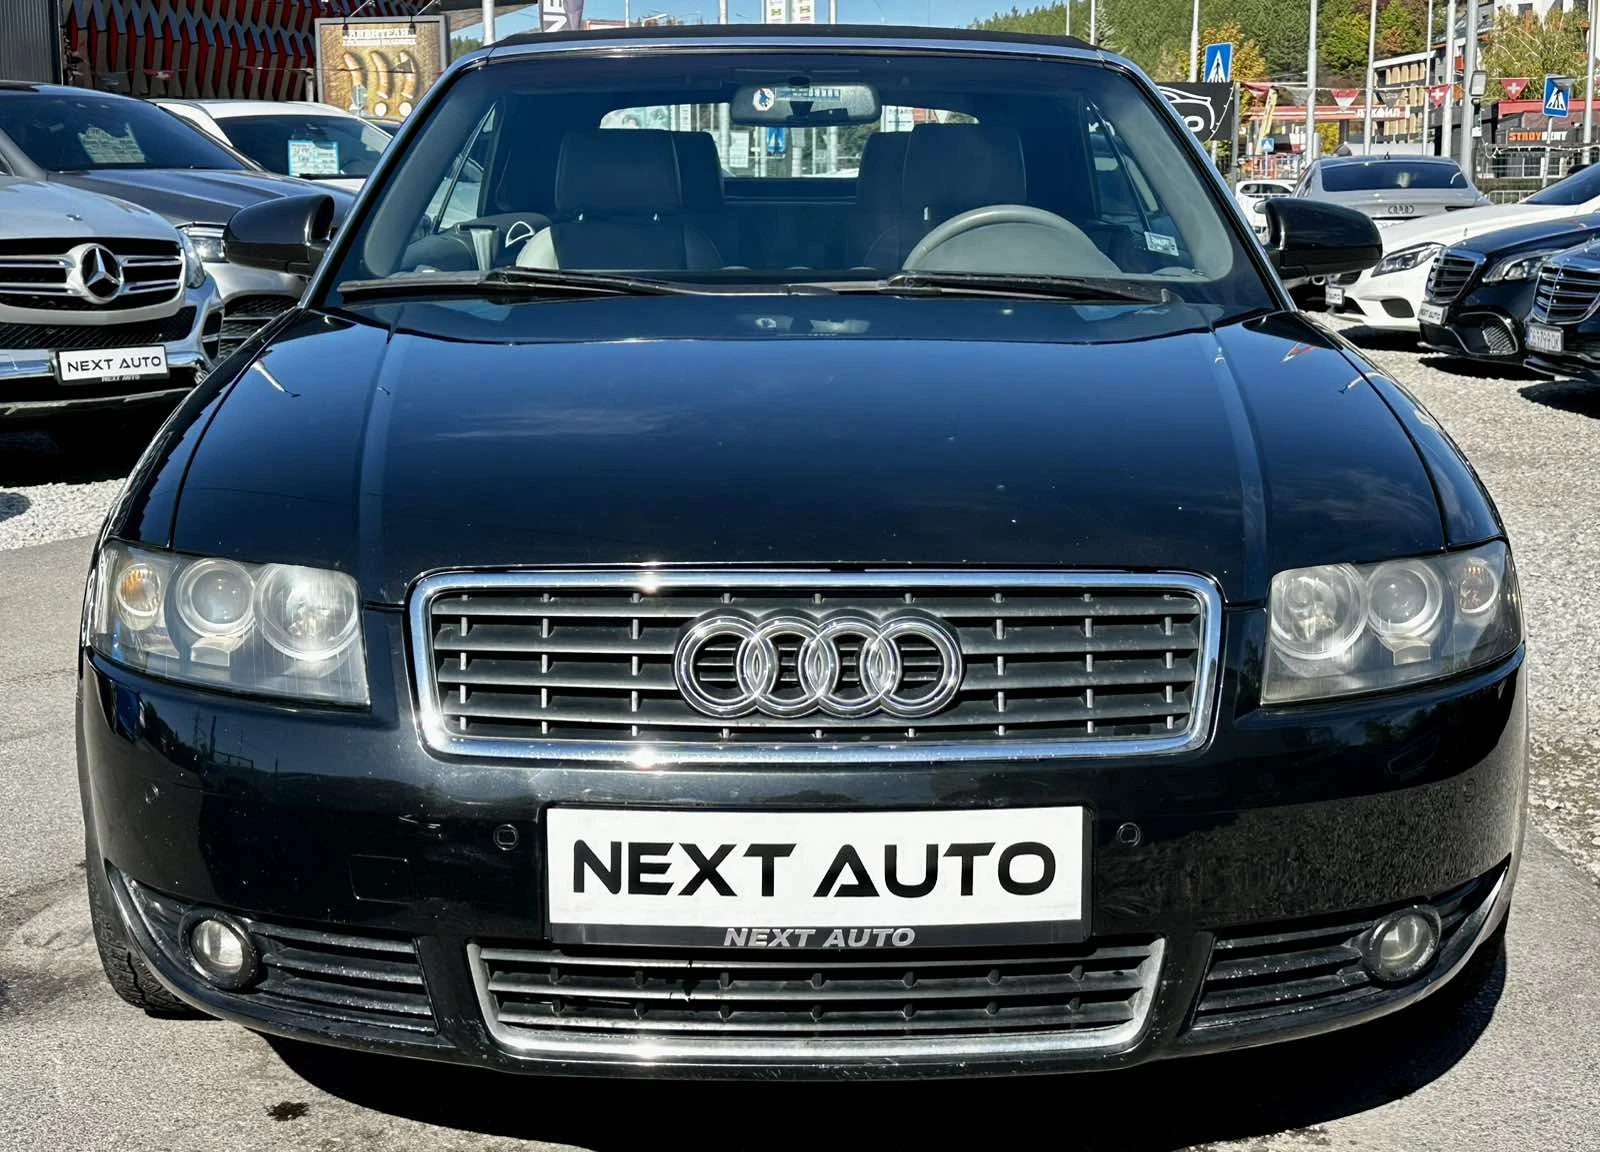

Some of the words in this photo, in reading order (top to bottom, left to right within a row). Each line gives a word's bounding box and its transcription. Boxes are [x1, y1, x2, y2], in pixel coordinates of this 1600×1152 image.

[1357, 105, 1400, 119] ЛКОЙЛ
[67, 359, 114, 372] NEXT
[119, 356, 161, 369] AUTO
[573, 839, 797, 898] NEXT
[813, 841, 1056, 898] AUTO
[723, 928, 816, 947] NEXT
[822, 928, 916, 947] AUTO
